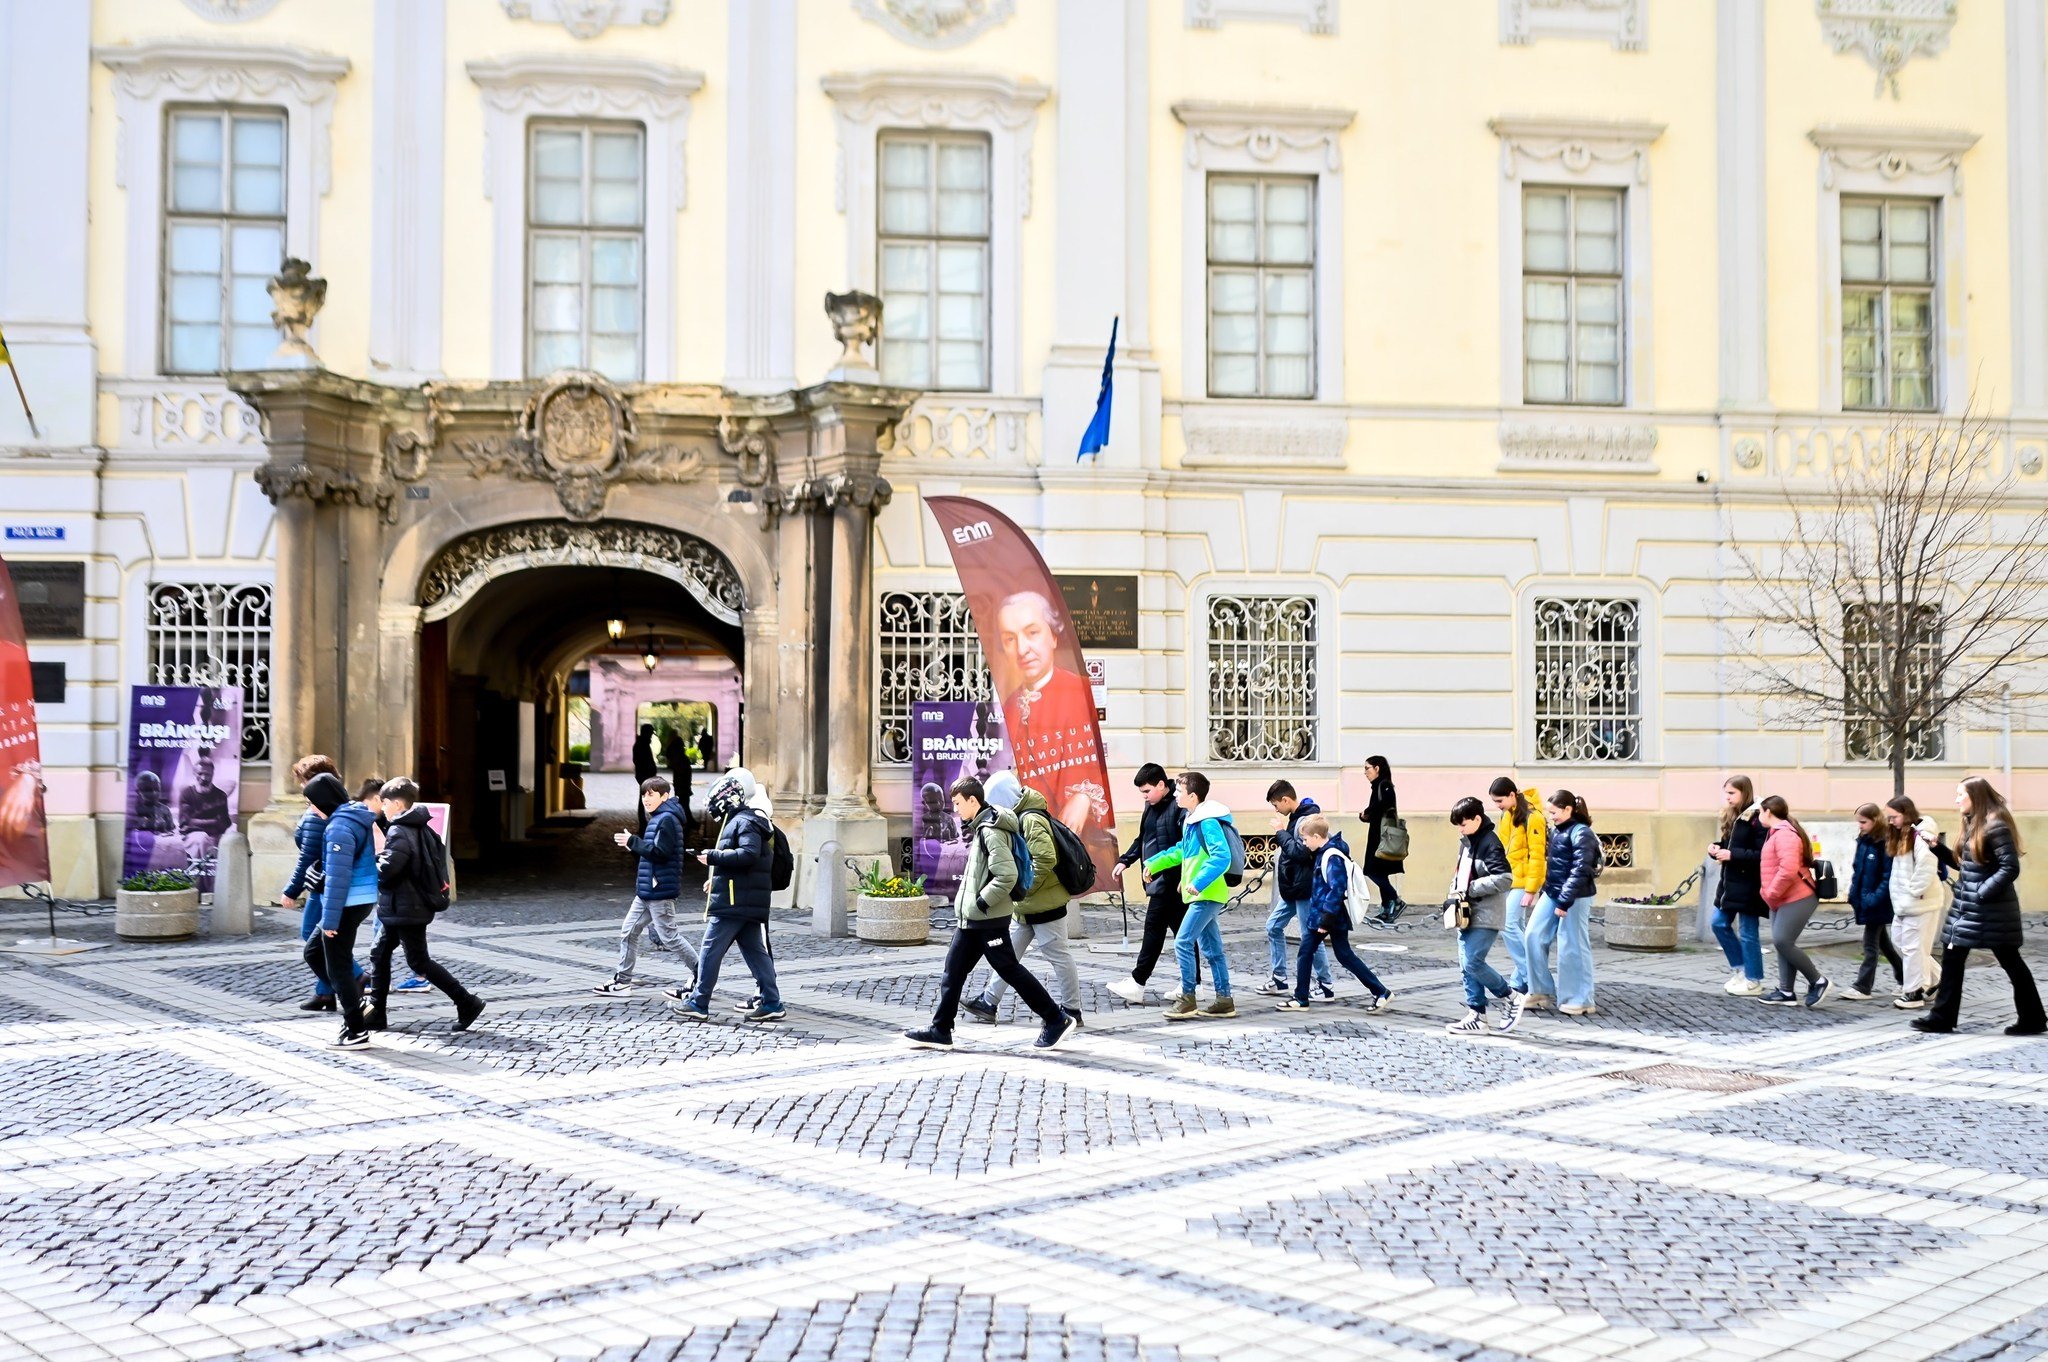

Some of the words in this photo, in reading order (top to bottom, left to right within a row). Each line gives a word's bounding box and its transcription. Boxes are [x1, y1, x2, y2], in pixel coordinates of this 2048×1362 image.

[139, 719, 231, 743] BRÂNCUȘI
[138, 739, 152, 748] LA
[154, 739, 217, 749] BRUKENTHAL
[922, 734, 1004, 755] BRÂNCUȘI
[922, 752, 934, 760] LA
[936, 752, 992, 760] BRUKENTHAL
